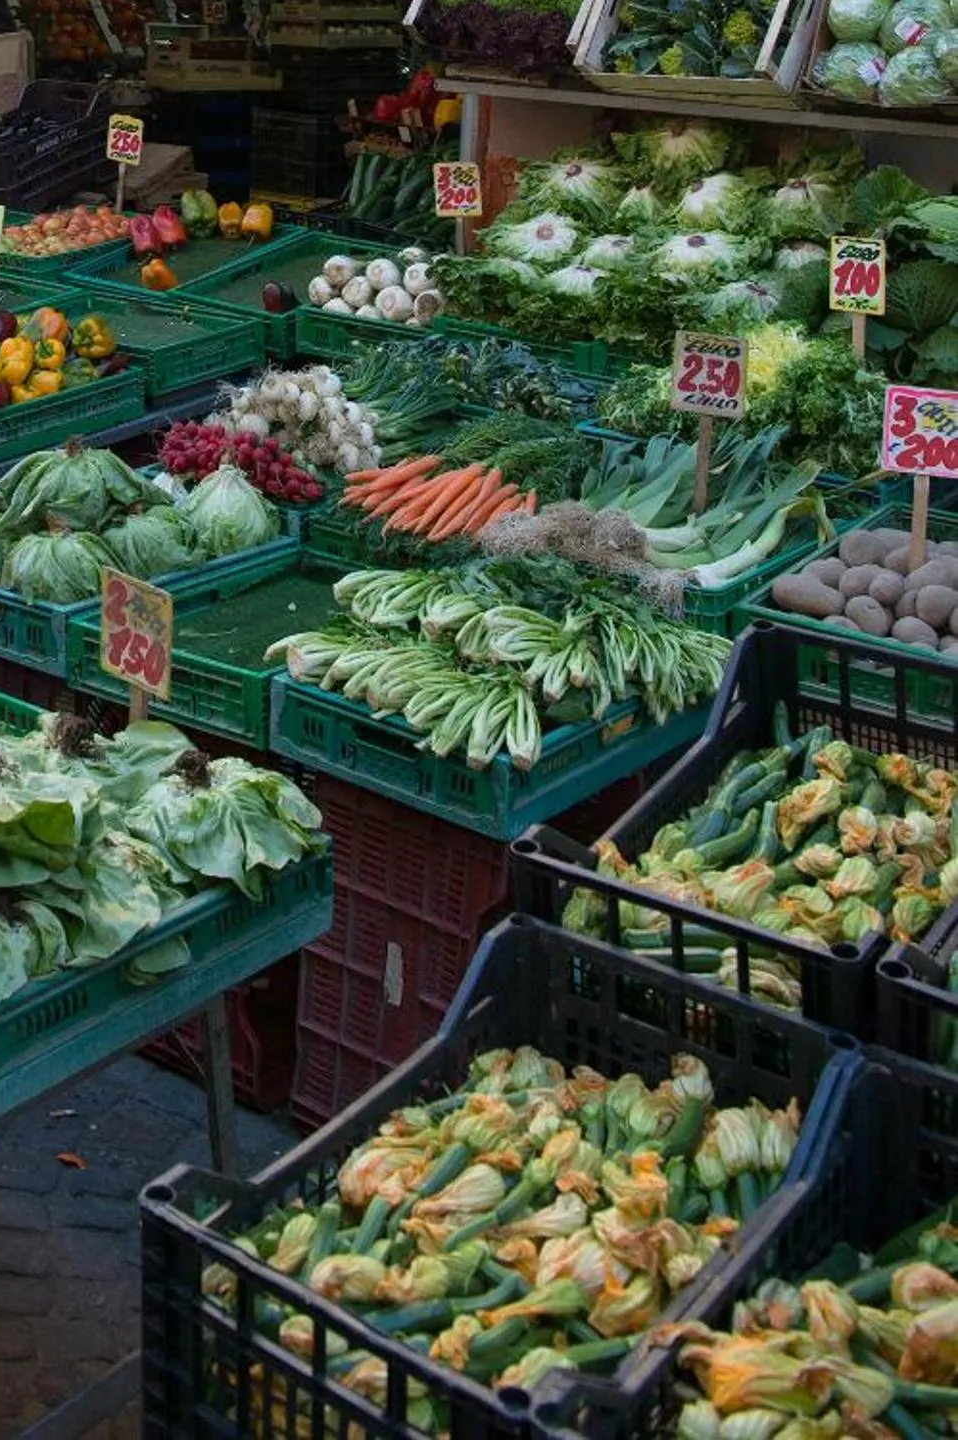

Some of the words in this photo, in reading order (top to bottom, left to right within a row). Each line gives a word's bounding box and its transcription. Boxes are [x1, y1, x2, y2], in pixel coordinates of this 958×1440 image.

[684, 340, 740, 358] EURO
[890, 395, 918, 438] 3
[105, 580, 128, 627] 2
